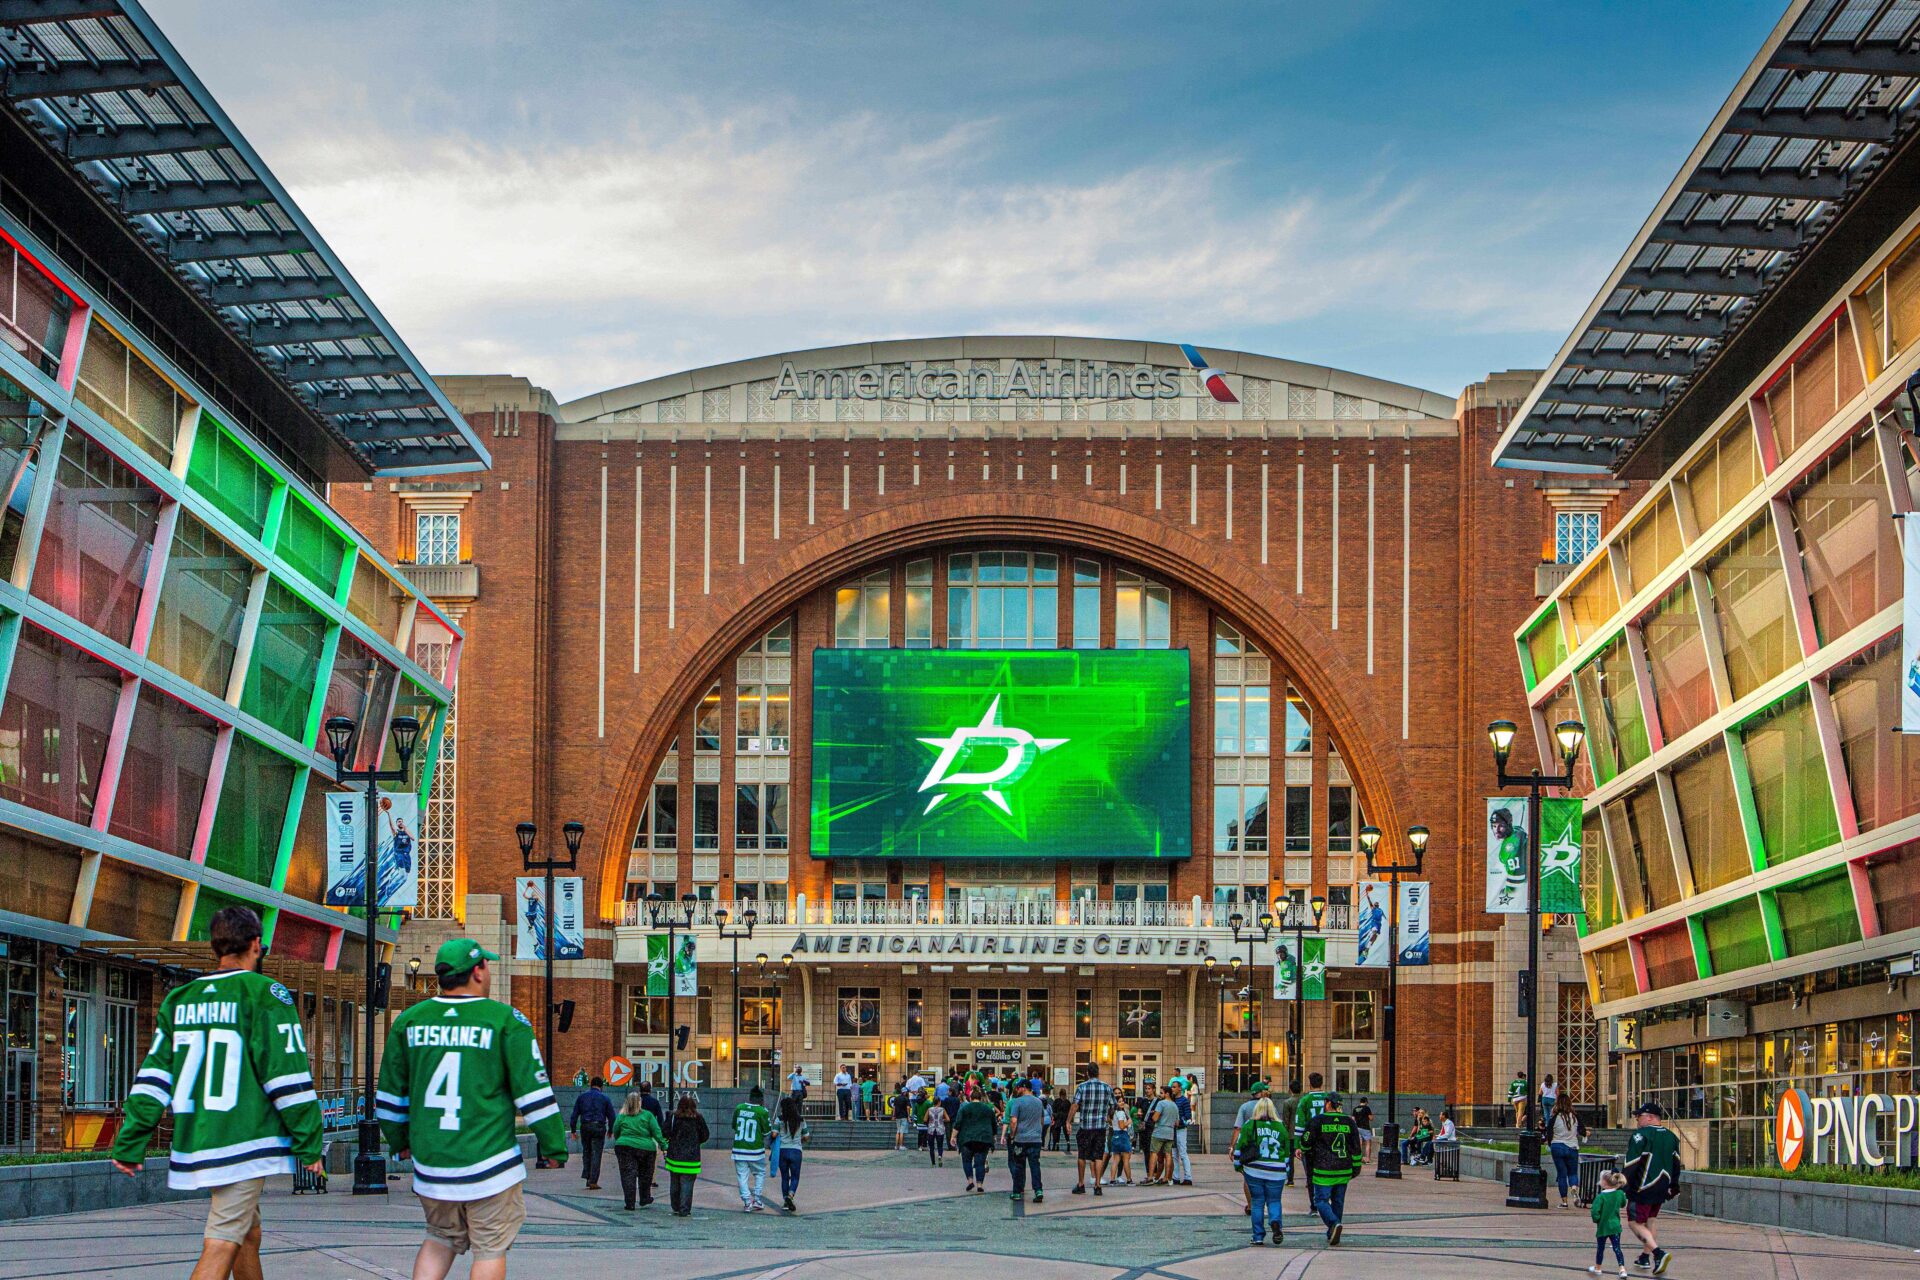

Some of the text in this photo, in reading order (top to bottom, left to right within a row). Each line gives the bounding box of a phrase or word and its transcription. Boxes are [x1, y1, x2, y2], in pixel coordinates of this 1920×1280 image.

[770, 358, 1180, 400] American Airlines
[1507, 857, 1520, 870] 91
[174, 1001, 238, 1025] DAMIANI
[406, 1025, 494, 1050] HEISKANEN
[171, 1028, 243, 1113] 70
[638, 1060, 704, 1084] PNC
[424, 1051, 462, 1131] 4
[735, 1117, 757, 1142] 30
[1810, 1094, 1920, 1168] PNC P
[1259, 1136, 1280, 1159] 47
[1331, 1132, 1347, 1158] 4
